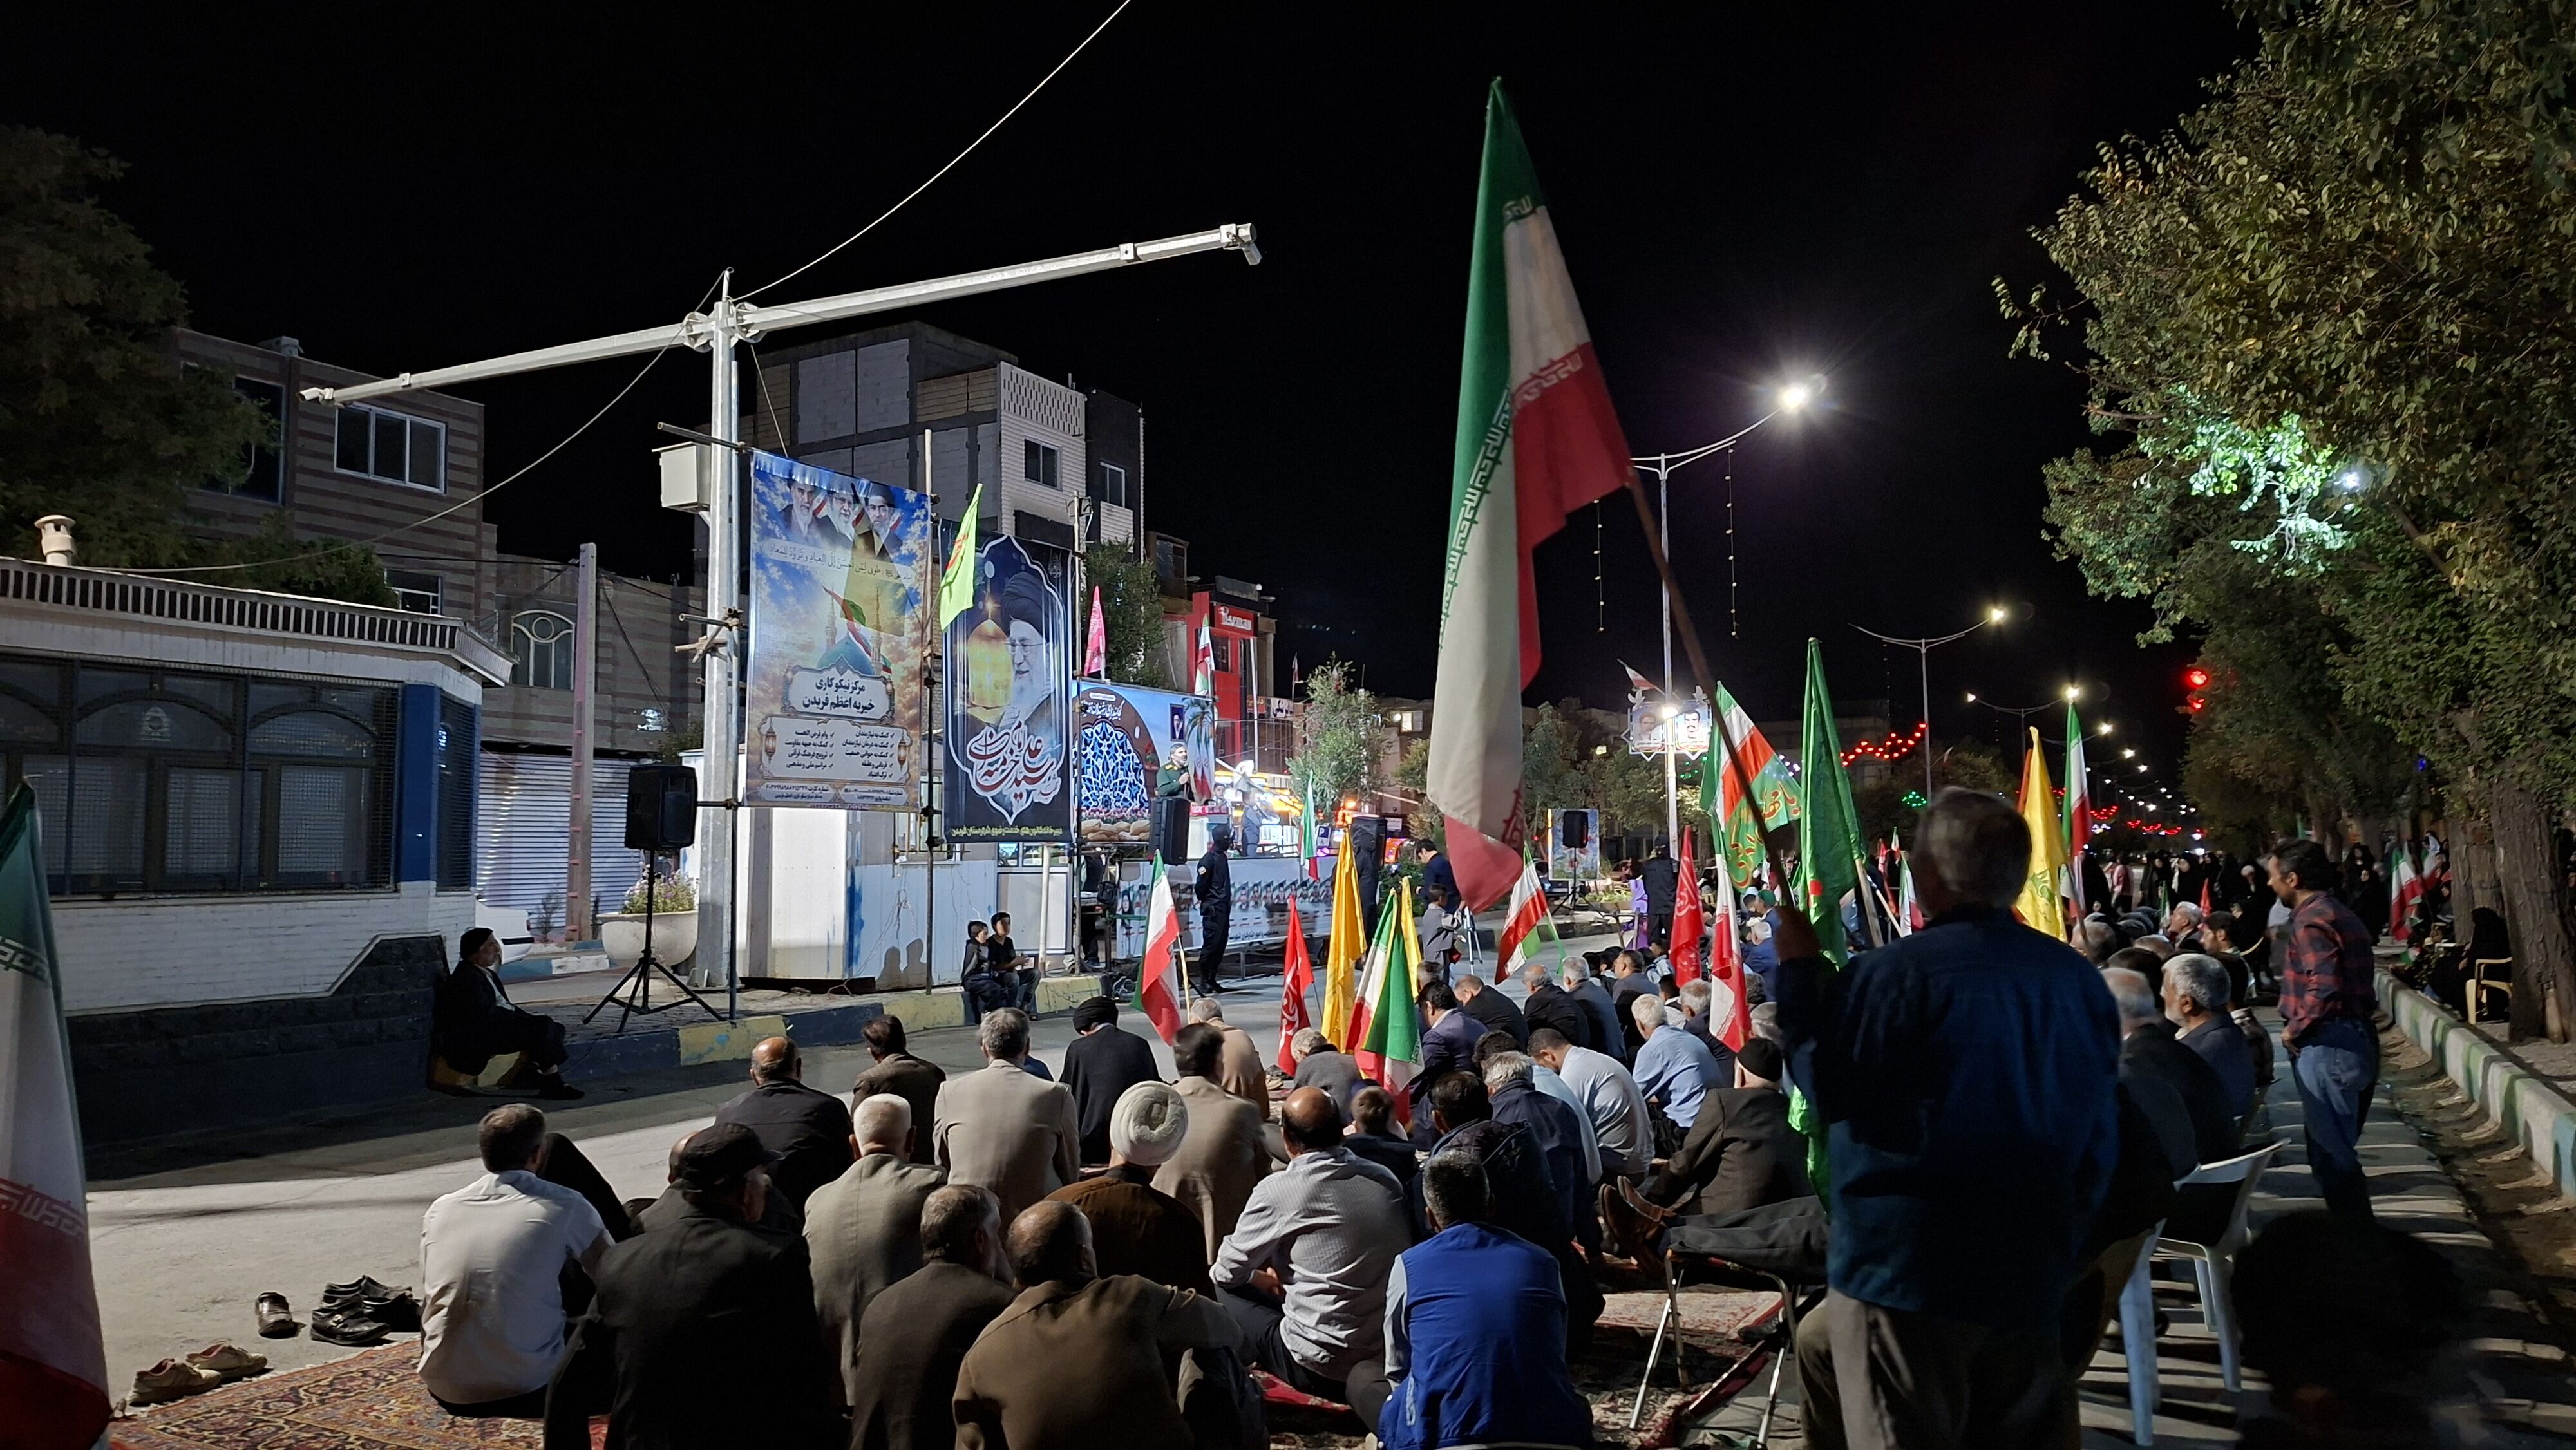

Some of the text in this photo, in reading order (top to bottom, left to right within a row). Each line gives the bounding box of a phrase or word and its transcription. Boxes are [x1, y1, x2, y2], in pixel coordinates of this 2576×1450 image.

[849, 680, 866, 695] مرکز
[802, 693, 875, 714] خیریه اعظم فریدن
[1319, 827, 1325, 836] P
